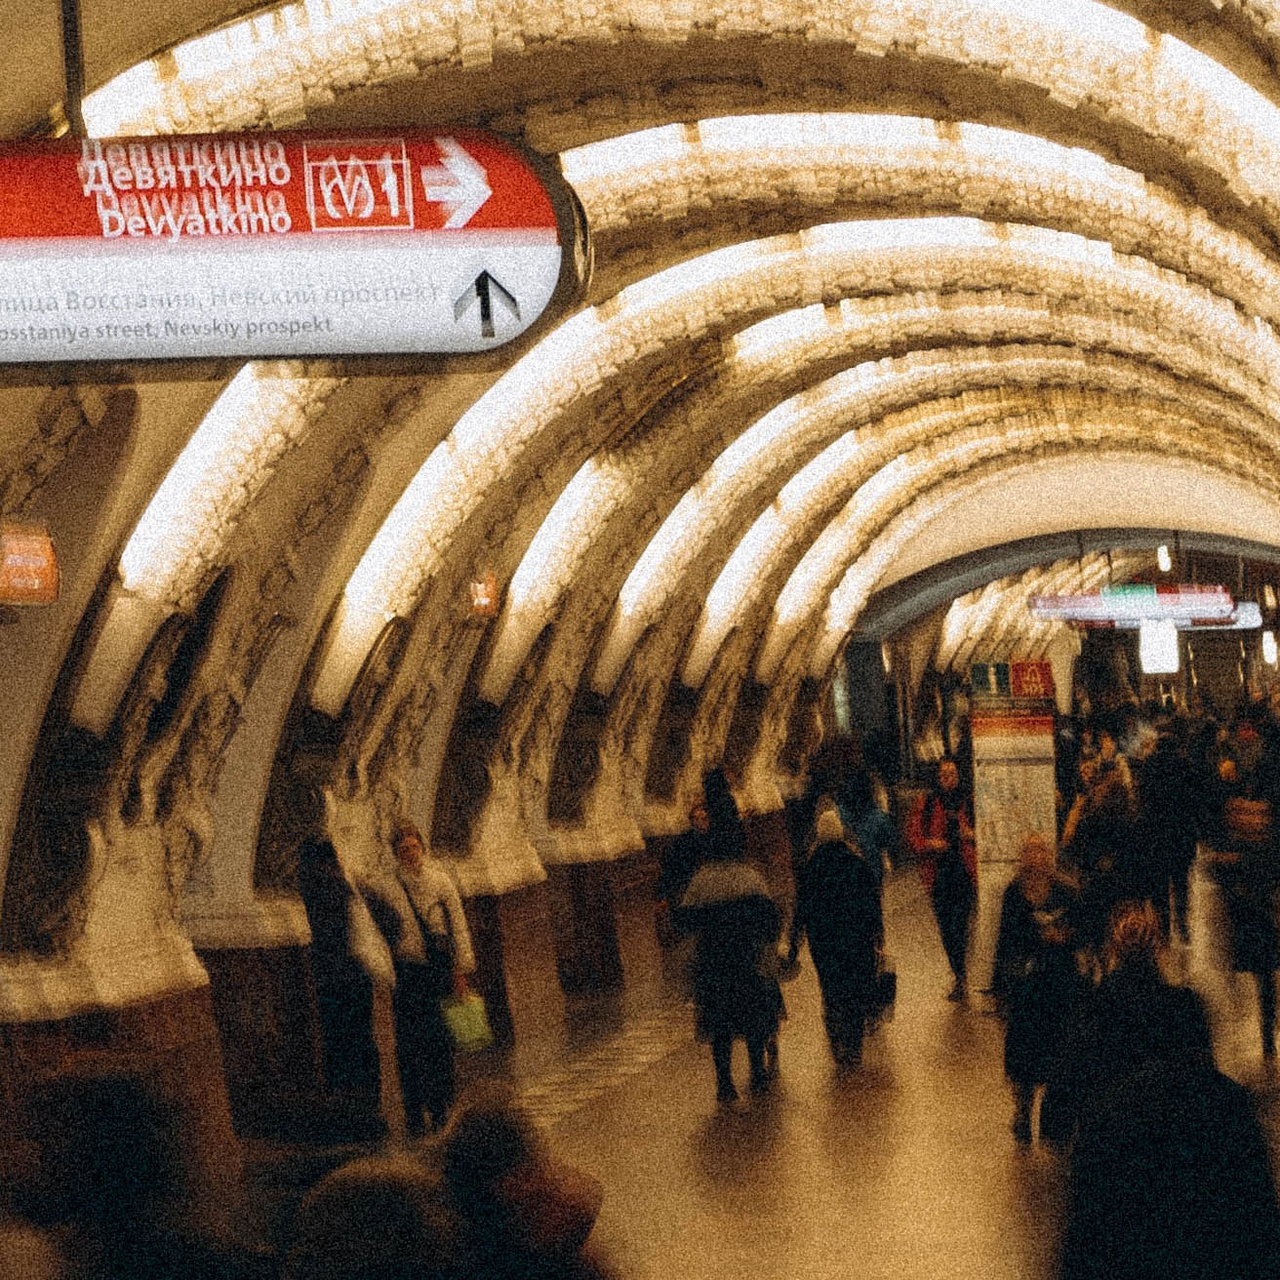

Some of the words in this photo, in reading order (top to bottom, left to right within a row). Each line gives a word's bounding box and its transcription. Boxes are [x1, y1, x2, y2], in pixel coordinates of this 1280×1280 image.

[80, 147, 291, 196] Девяткино
[99, 200, 293, 242] Devyatkino
[211, 285, 317, 306] Невский
[325, 284, 438, 308] проспект
[164, 318, 240, 339] Nevskiy
[245, 315, 333, 338] prospekt
